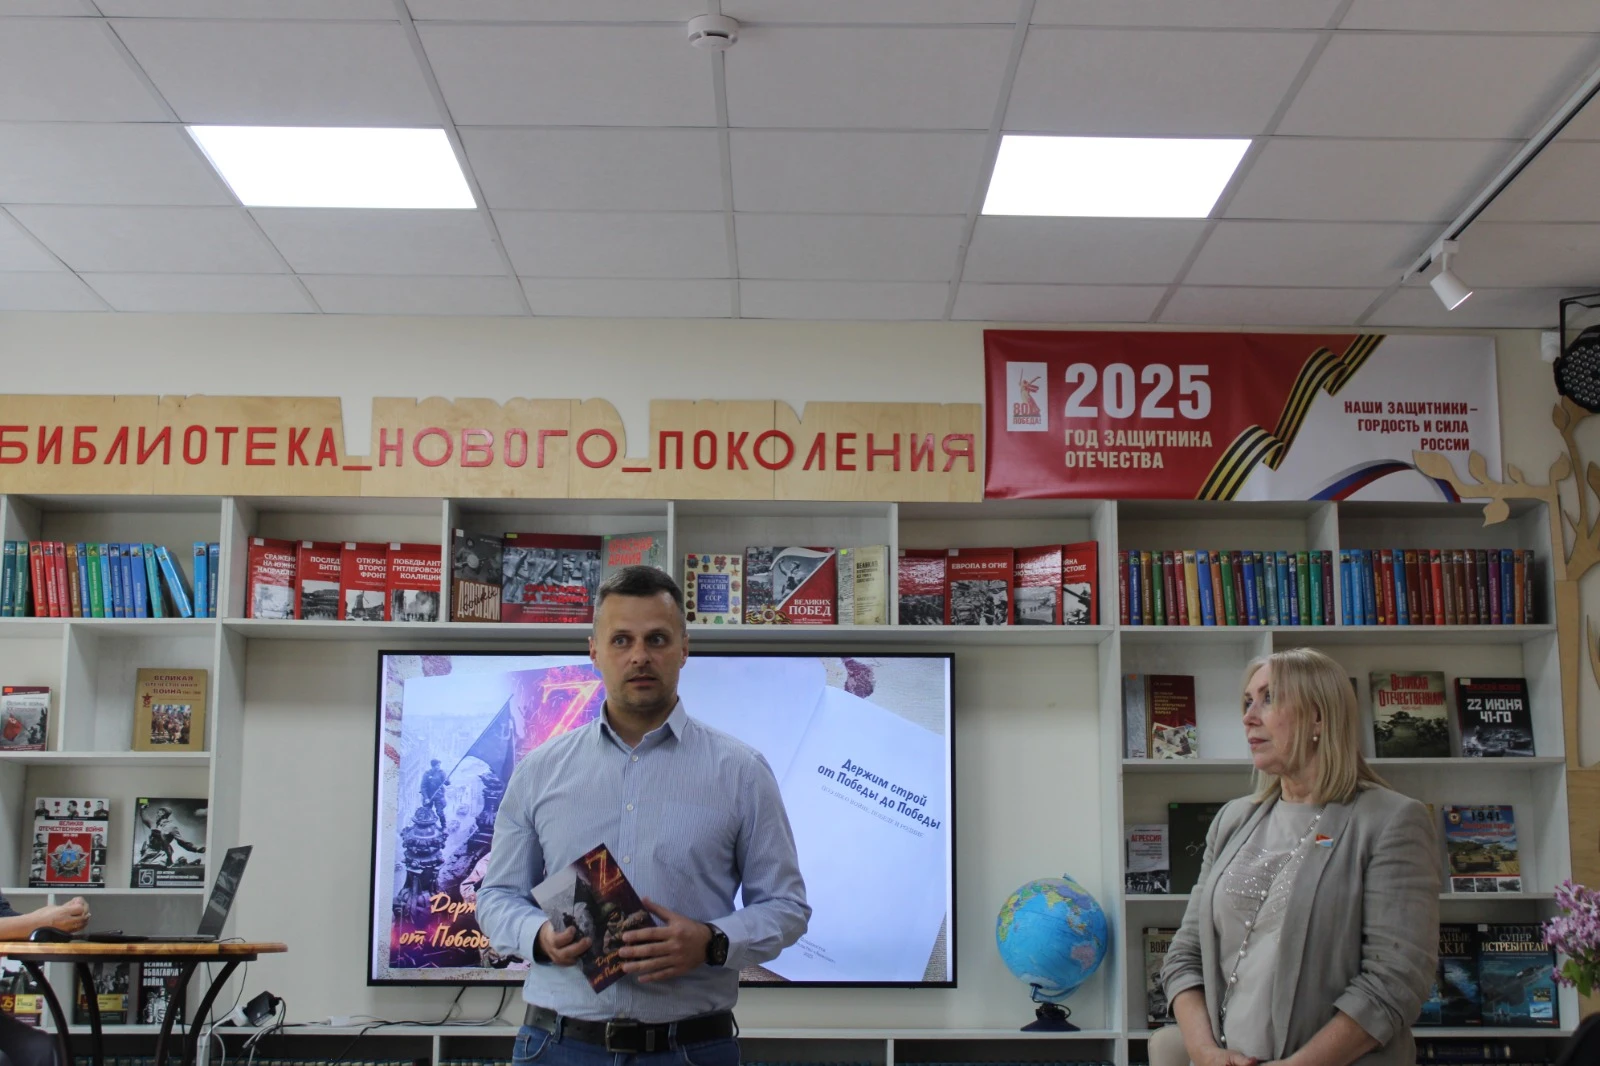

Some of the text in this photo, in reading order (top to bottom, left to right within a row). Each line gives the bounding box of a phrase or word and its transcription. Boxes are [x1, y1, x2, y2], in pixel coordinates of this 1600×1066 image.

[1064, 362, 1212, 419] 2025
[1344, 401, 1383, 414] НАШИ
[1012, 417, 1042, 425] ПОБЕДА!
[1357, 419, 1469, 434] ГОРДОСТЬ И СИЛА
[1064, 429, 1213, 449] ГОД ЗАЩИТНИКА
[1420, 438, 1470, 451] РОССИИ
[1065, 451, 1164, 469] ОТЕЧЕСТВА
[608, 536, 653, 553] КРАСНАЯ
[393, 558, 426, 566] ПОБЕДЫ
[607, 551, 642, 567] АРМИЯ
[951, 562, 981, 570] ЕВРОПА
[988, 561, 1008, 569] ОГНЕ
[794, 598, 832, 606] ВЕЛИКИХ
[788, 605, 832, 617] ПОБЕД
[1466, 698, 1523, 711] 22 ИЮНЯ
[1480, 710, 1513, 723] 41-ГО
[841, 758, 928, 807] Держим строй
[817, 764, 941, 830] от Победы до Победы
[1471, 810, 1500, 821] 1941
[399, 930, 427, 946] от
[1498, 933, 1532, 942] СУПЕР
[1481, 941, 1549, 952] ИСТРЕБИТЕЛИ
